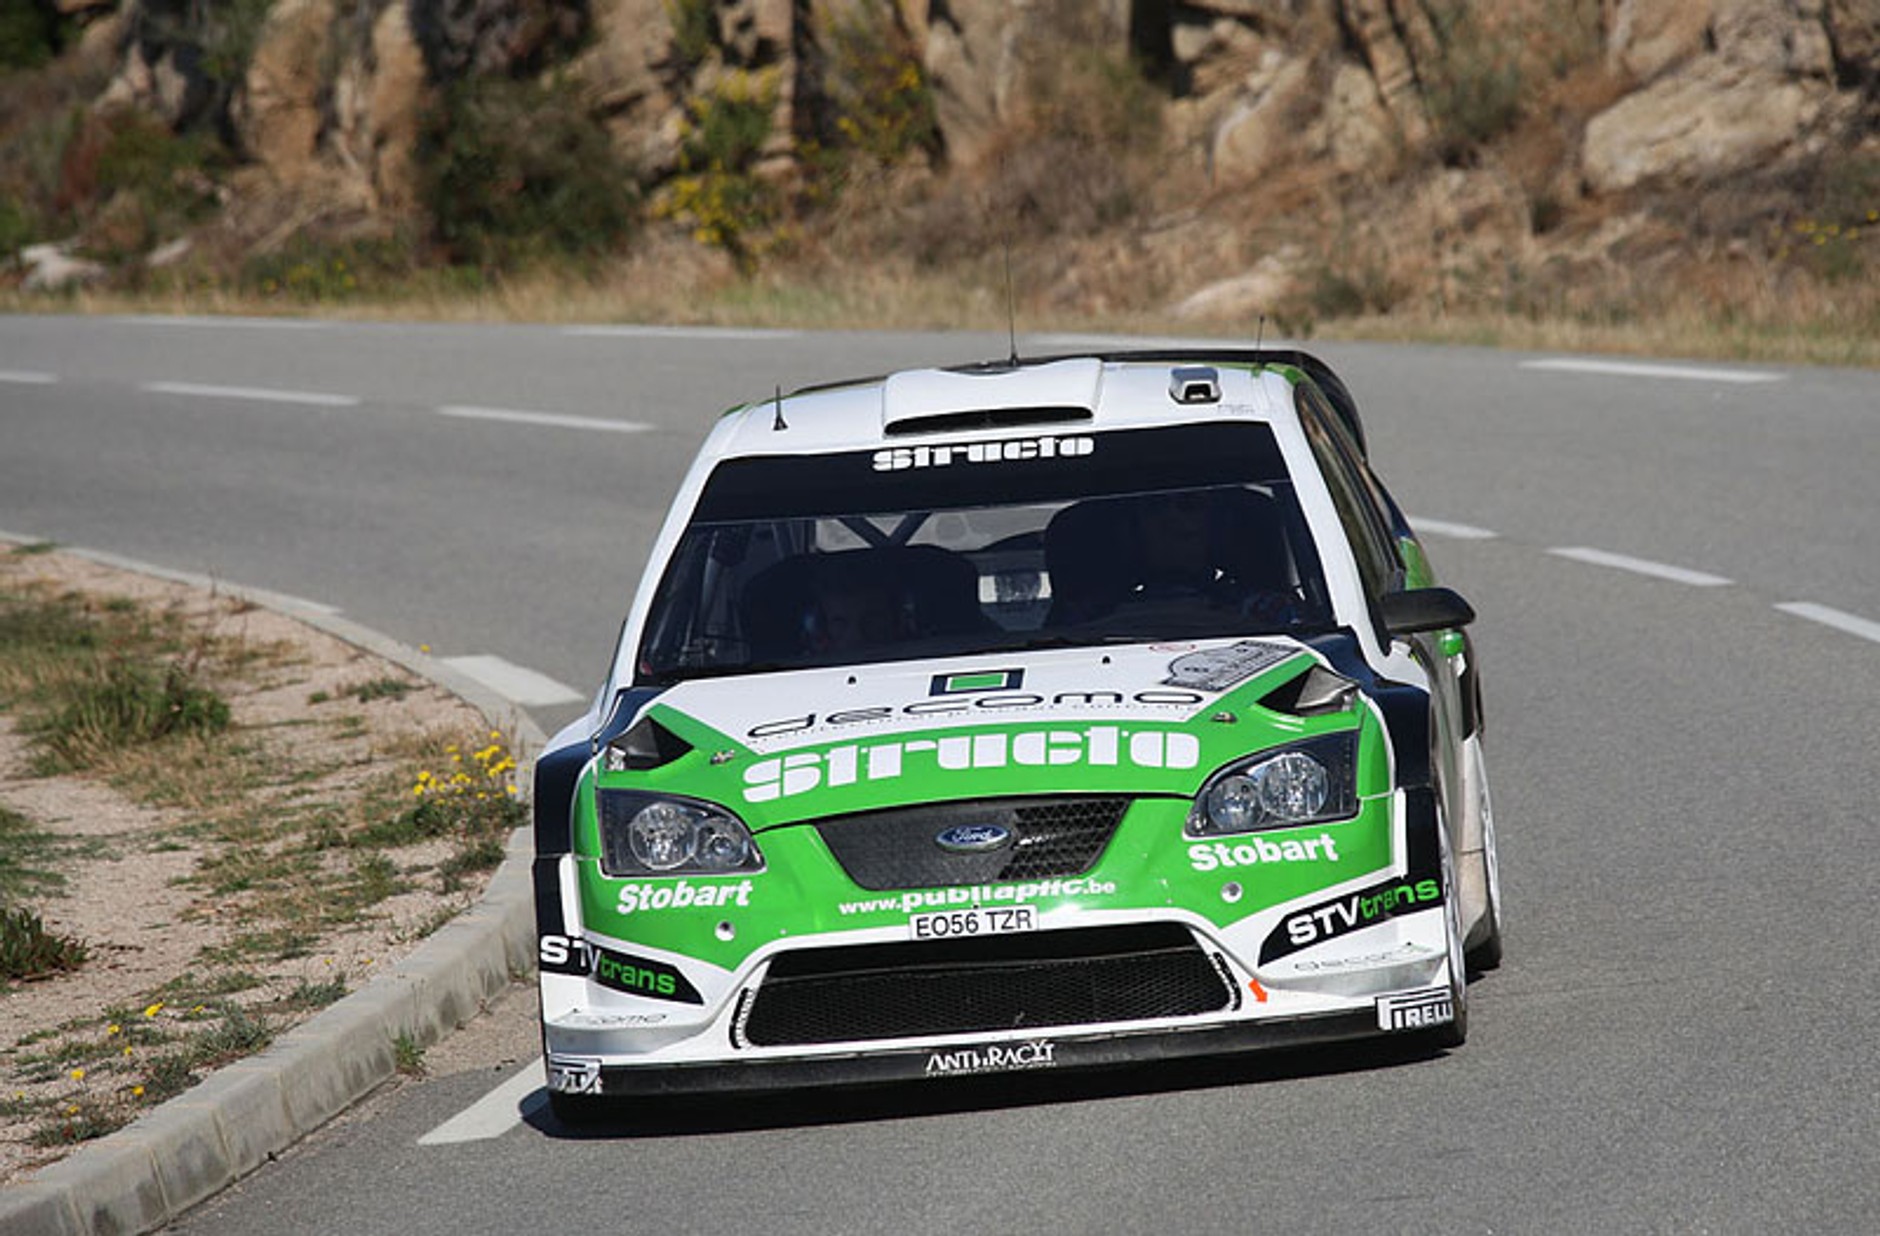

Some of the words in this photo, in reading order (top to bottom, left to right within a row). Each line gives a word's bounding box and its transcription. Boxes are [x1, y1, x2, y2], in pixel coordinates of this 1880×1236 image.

[873, 437, 1094, 471] structo
[747, 691, 1204, 737] decomo
[742, 726, 1200, 803] structo
[951, 826, 994, 845] Ford
[1188, 833, 1339, 871] Stobart
[617, 880, 753, 915] Stobart
[1287, 879, 1440, 945] STVtrans
[916, 913, 979, 938] EO56
[985, 909, 1033, 933] TZR
